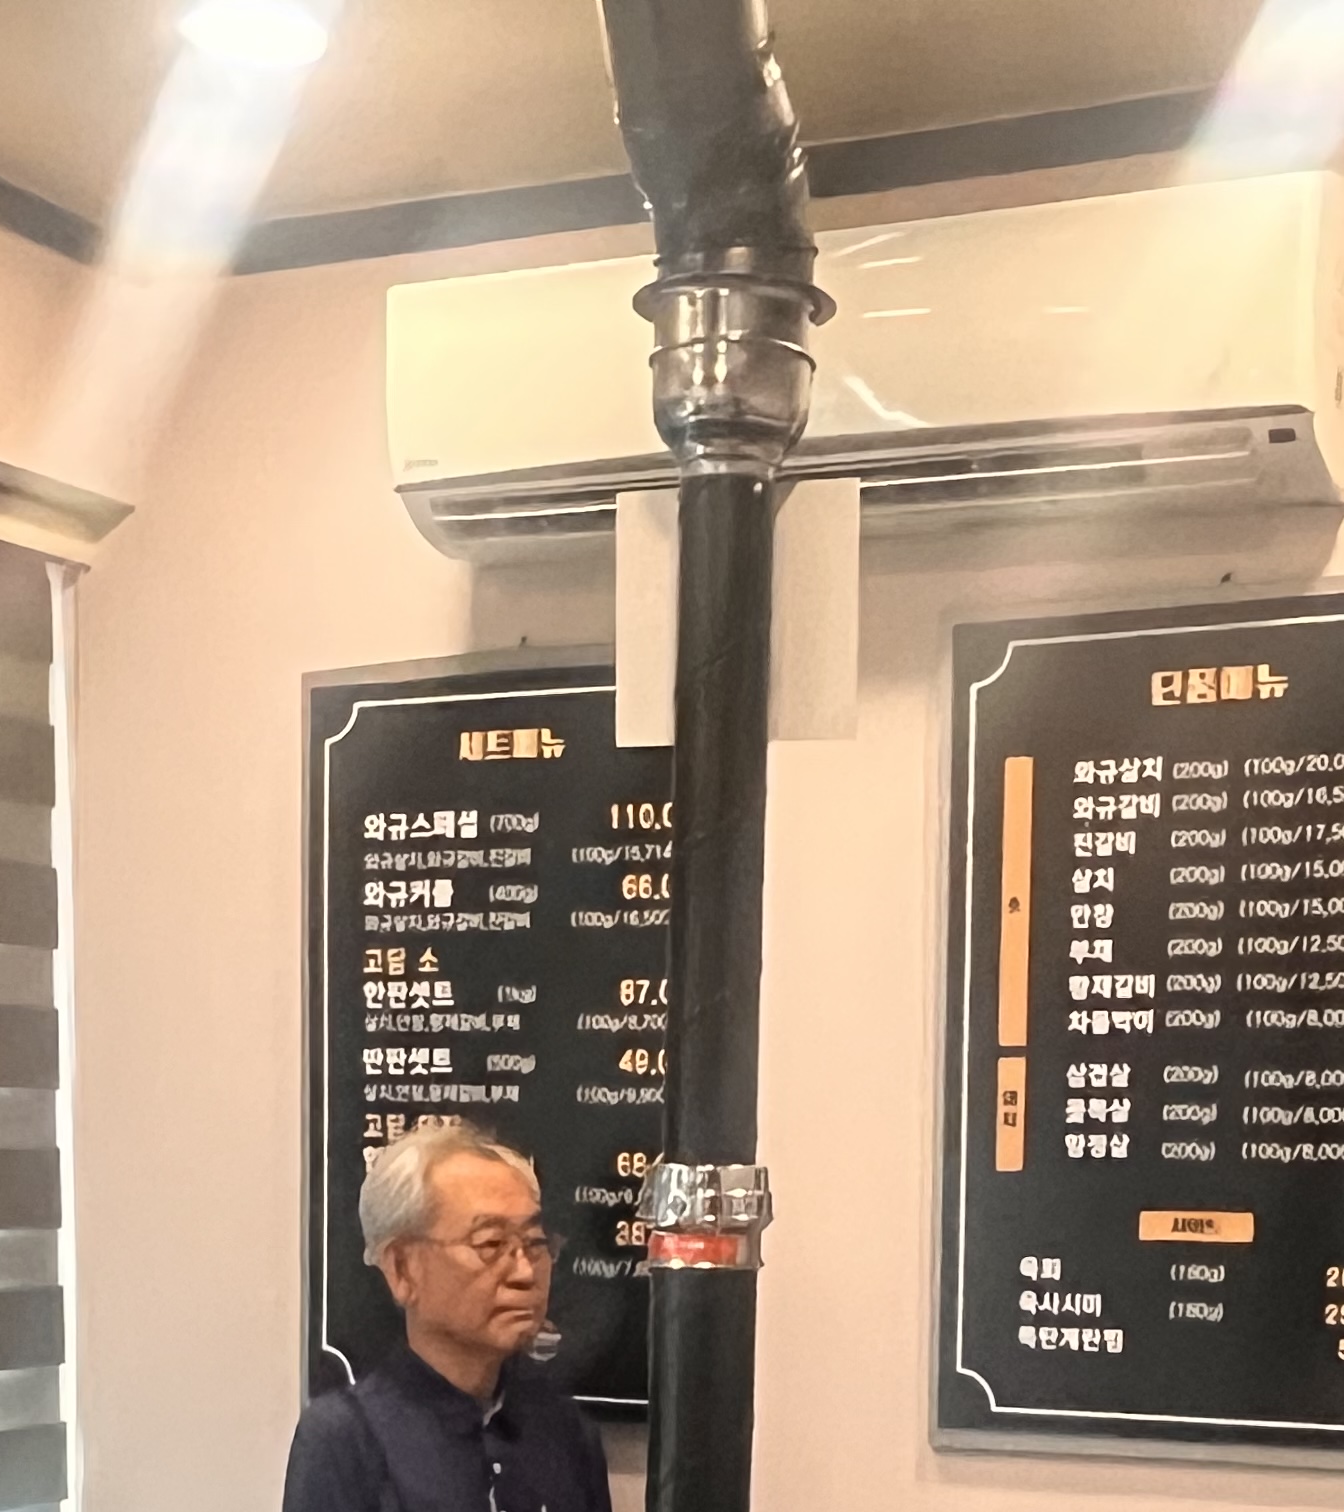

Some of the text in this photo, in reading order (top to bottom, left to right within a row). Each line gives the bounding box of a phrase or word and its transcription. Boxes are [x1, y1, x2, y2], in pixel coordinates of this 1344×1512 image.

[1152, 664, 1288, 705] 단품메뉴
[1073, 756, 1163, 784] 와규살치
[1173, 760, 1228, 779] (200g)
[1073, 793, 1160, 820] 와규갈비
[364, 810, 477, 840] 와규스페셜
[363, 879, 453, 908] 와규커플
[1068, 1009, 1154, 1034] 차돌박이
[1067, 1063, 1131, 1088] 삼겹살
[1065, 1134, 1129, 1158] 항정살
[1019, 1291, 1101, 1317] 육사시미
